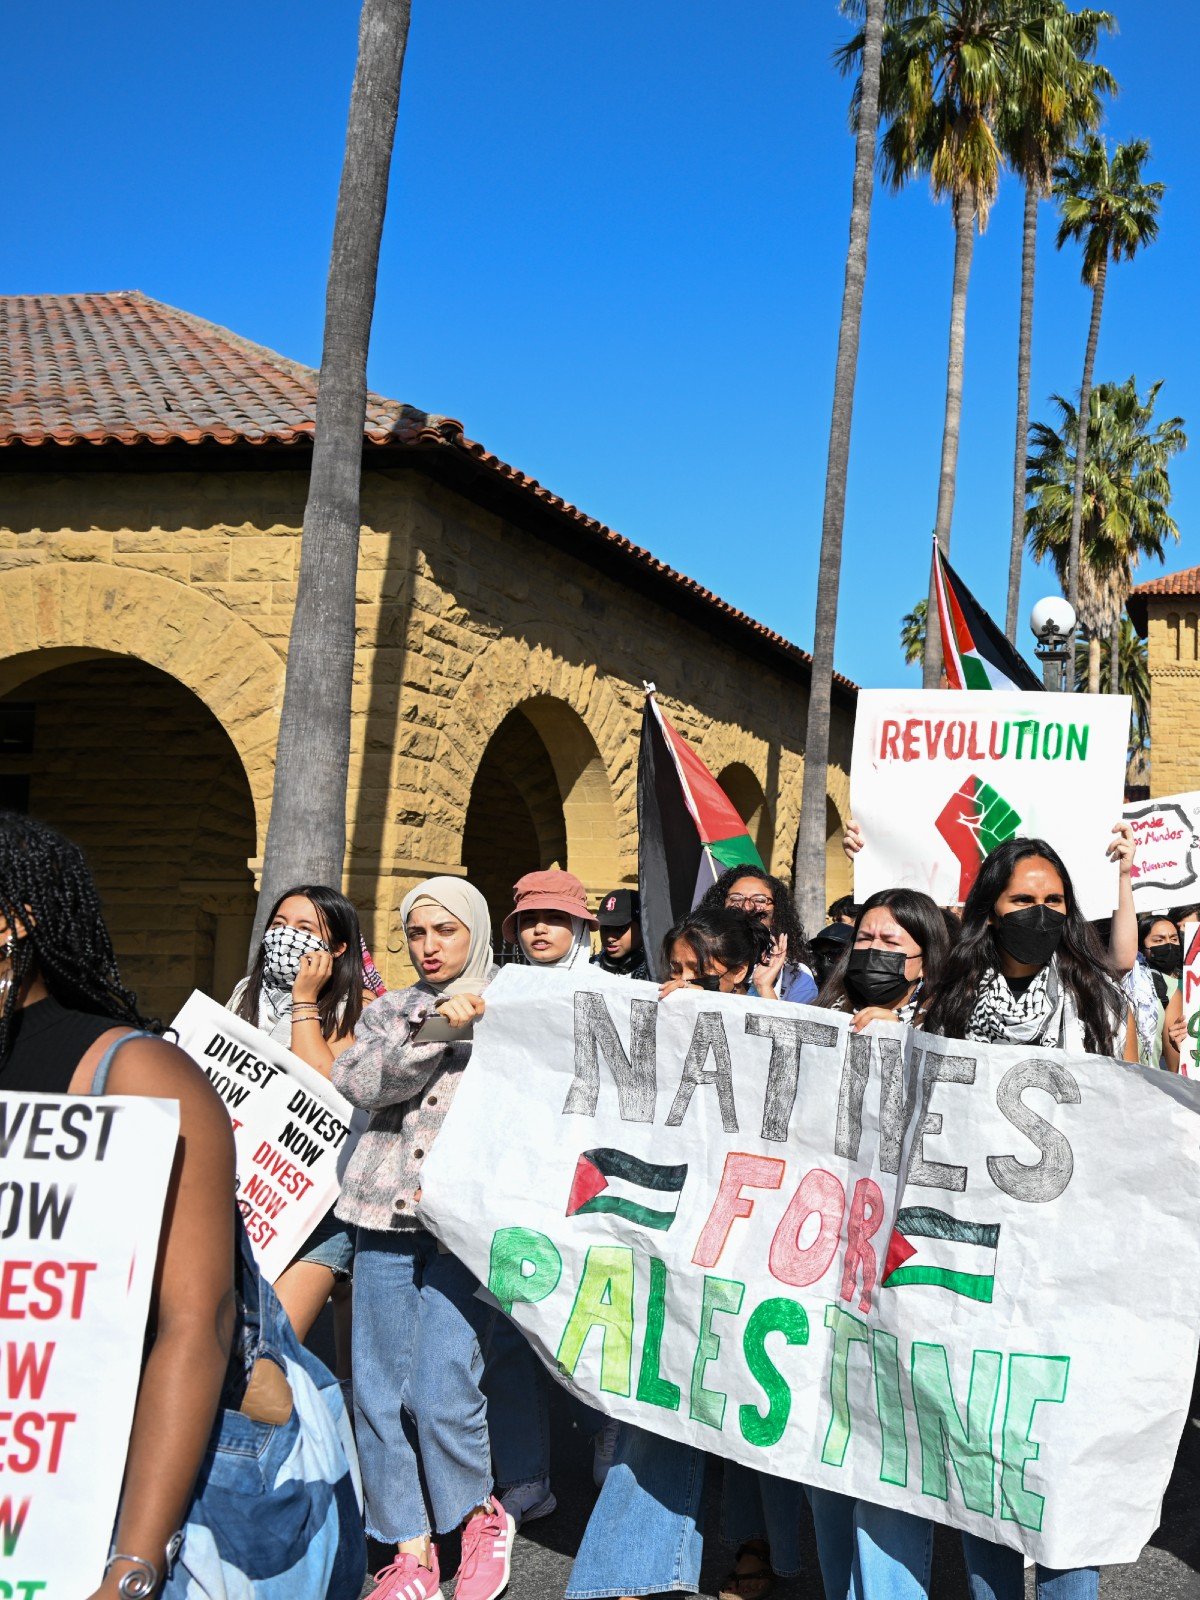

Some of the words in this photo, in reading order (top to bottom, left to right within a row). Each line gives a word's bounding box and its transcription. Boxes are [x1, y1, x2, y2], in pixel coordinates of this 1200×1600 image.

[879, 718, 1090, 762] REVOLUTION
[204, 1033, 279, 1090] DIVEST
[286, 1088, 352, 1149] DIVEST
[562, 990, 1083, 1204] NATIVES
[252, 1140, 315, 1201] DIVEST
[278, 1120, 325, 1168] NOW
[242, 1173, 288, 1221] NOW
[692, 1151, 886, 1314] FOR
[487, 1226, 1070, 1532] PALESTINE
